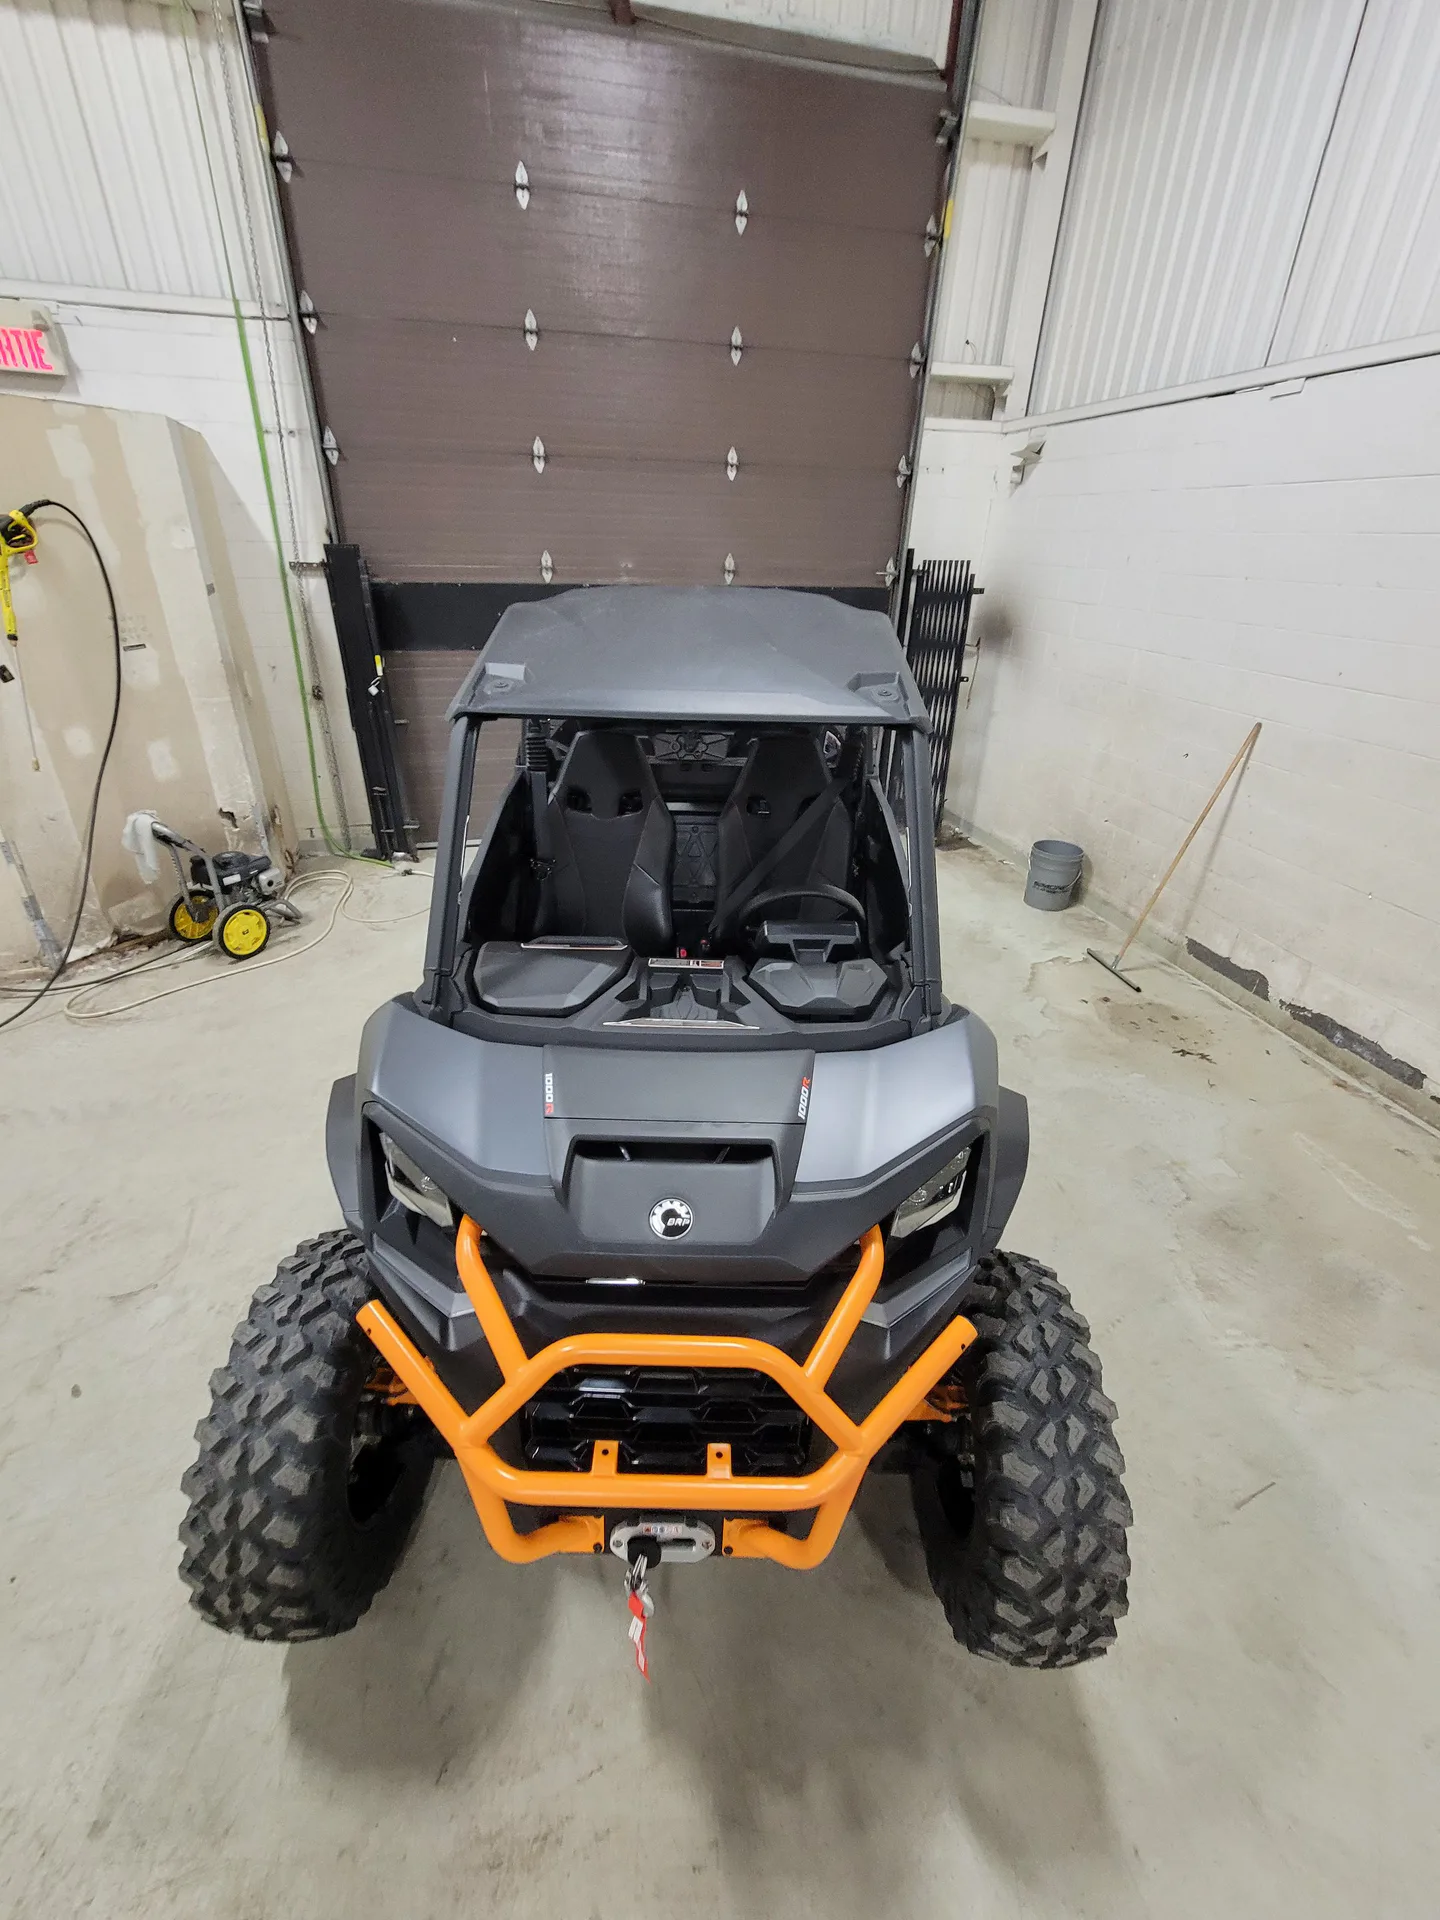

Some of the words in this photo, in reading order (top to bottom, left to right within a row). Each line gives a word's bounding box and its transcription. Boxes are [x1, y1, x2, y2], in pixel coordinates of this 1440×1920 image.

[0, 328, 53, 370] RTIE
[797, 1076, 811, 1120] 1000R
[667, 1217, 690, 1226] BRP
